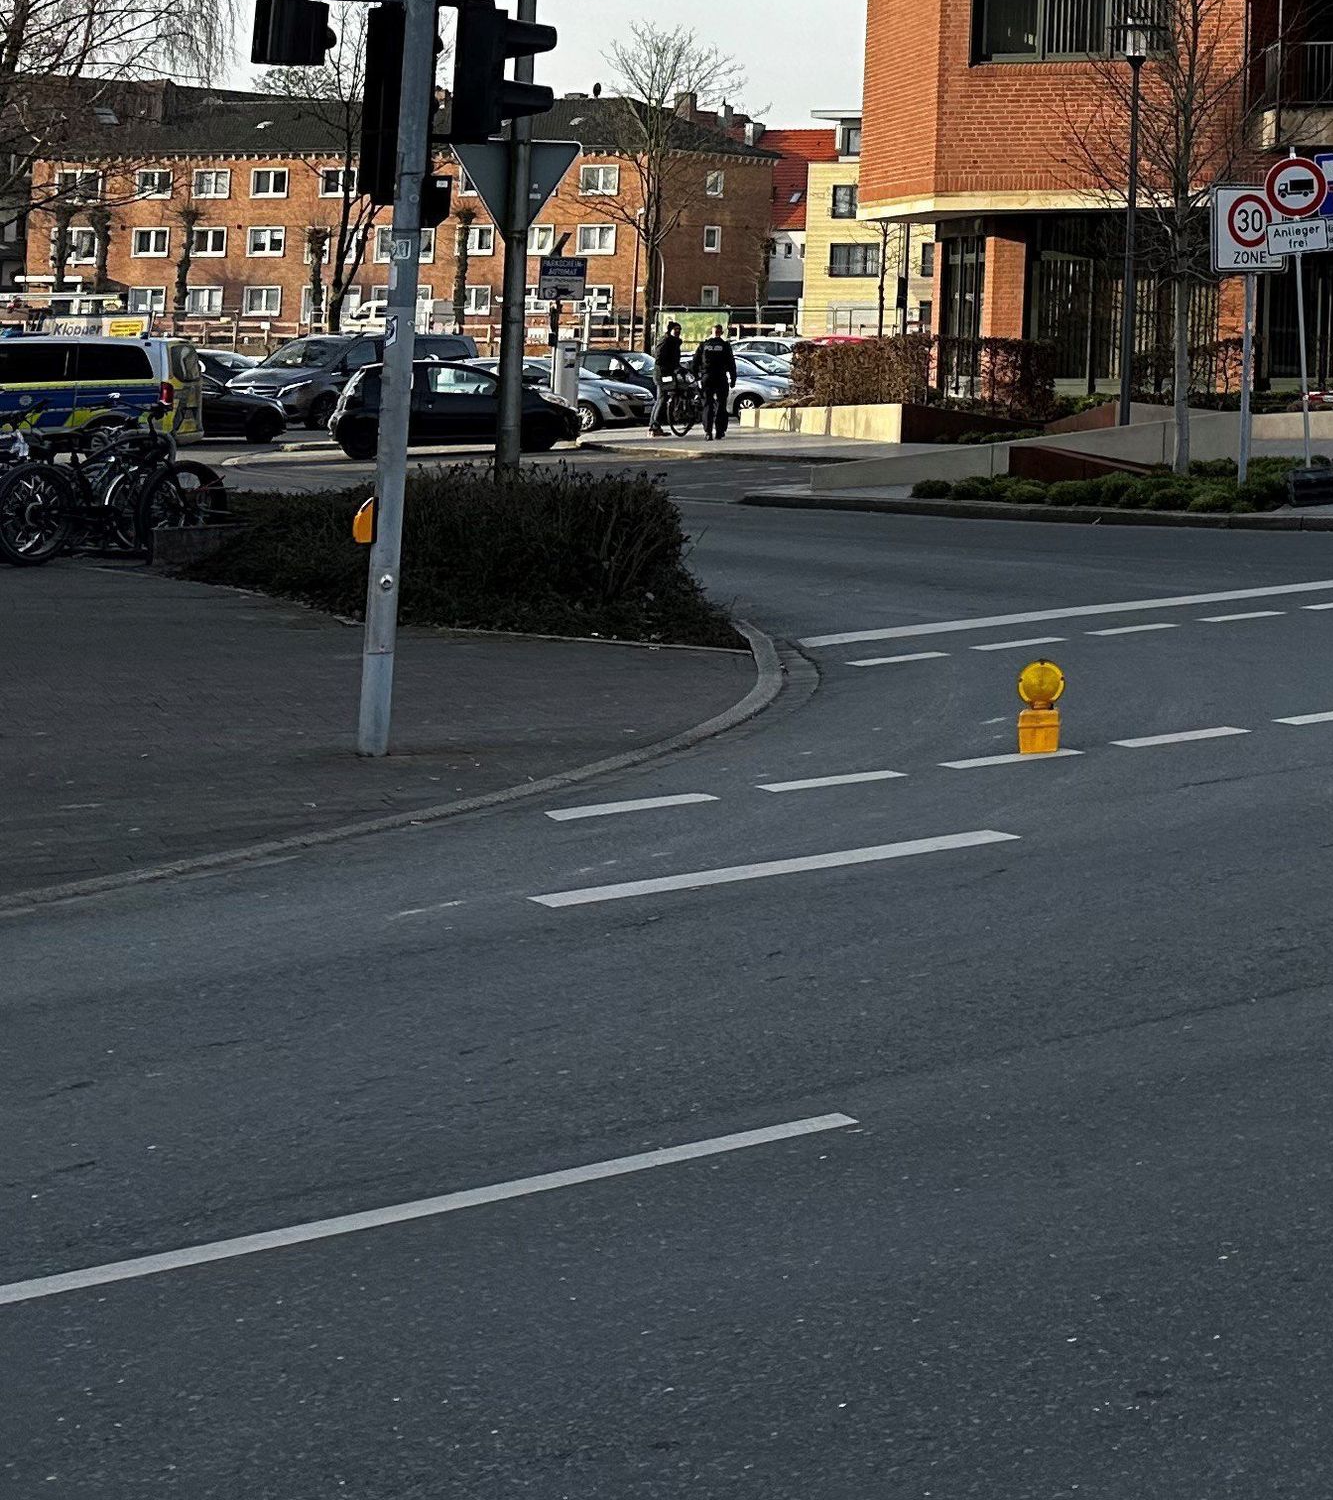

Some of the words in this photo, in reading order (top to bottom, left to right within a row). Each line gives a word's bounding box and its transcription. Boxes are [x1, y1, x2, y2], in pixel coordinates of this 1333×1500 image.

[1237, 209, 1263, 233] 30
[1273, 226, 1320, 238] Anlieger
[1289, 238, 1308, 249] frei
[1233, 251, 1268, 265] ZONE
